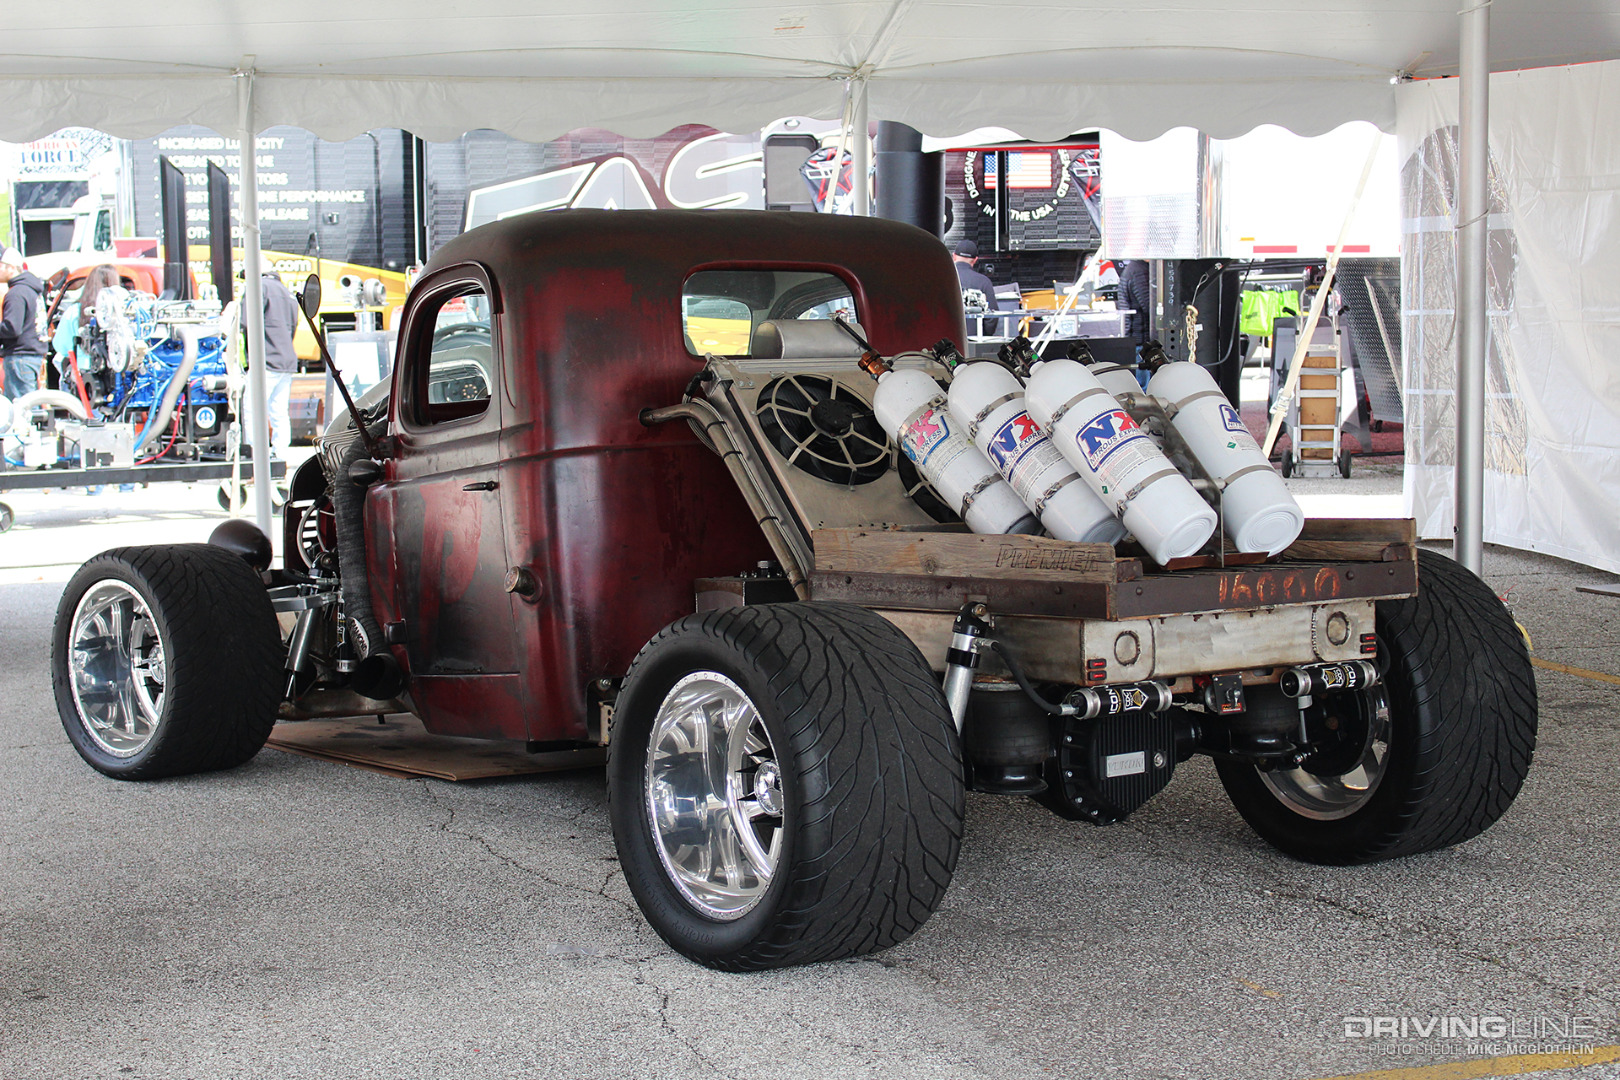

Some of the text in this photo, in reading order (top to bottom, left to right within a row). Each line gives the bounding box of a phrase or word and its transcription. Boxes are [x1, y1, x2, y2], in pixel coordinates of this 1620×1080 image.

[21, 150, 80, 164] FORCE
[964, 151, 980, 199] DESIGNE
[983, 203, 1054, 221] IN THE USA
[990, 412, 1041, 470] NX
[1080, 411, 1140, 458] NX
[1089, 436, 1118, 464] NITROUS
[1106, 688, 1119, 714] ICON
